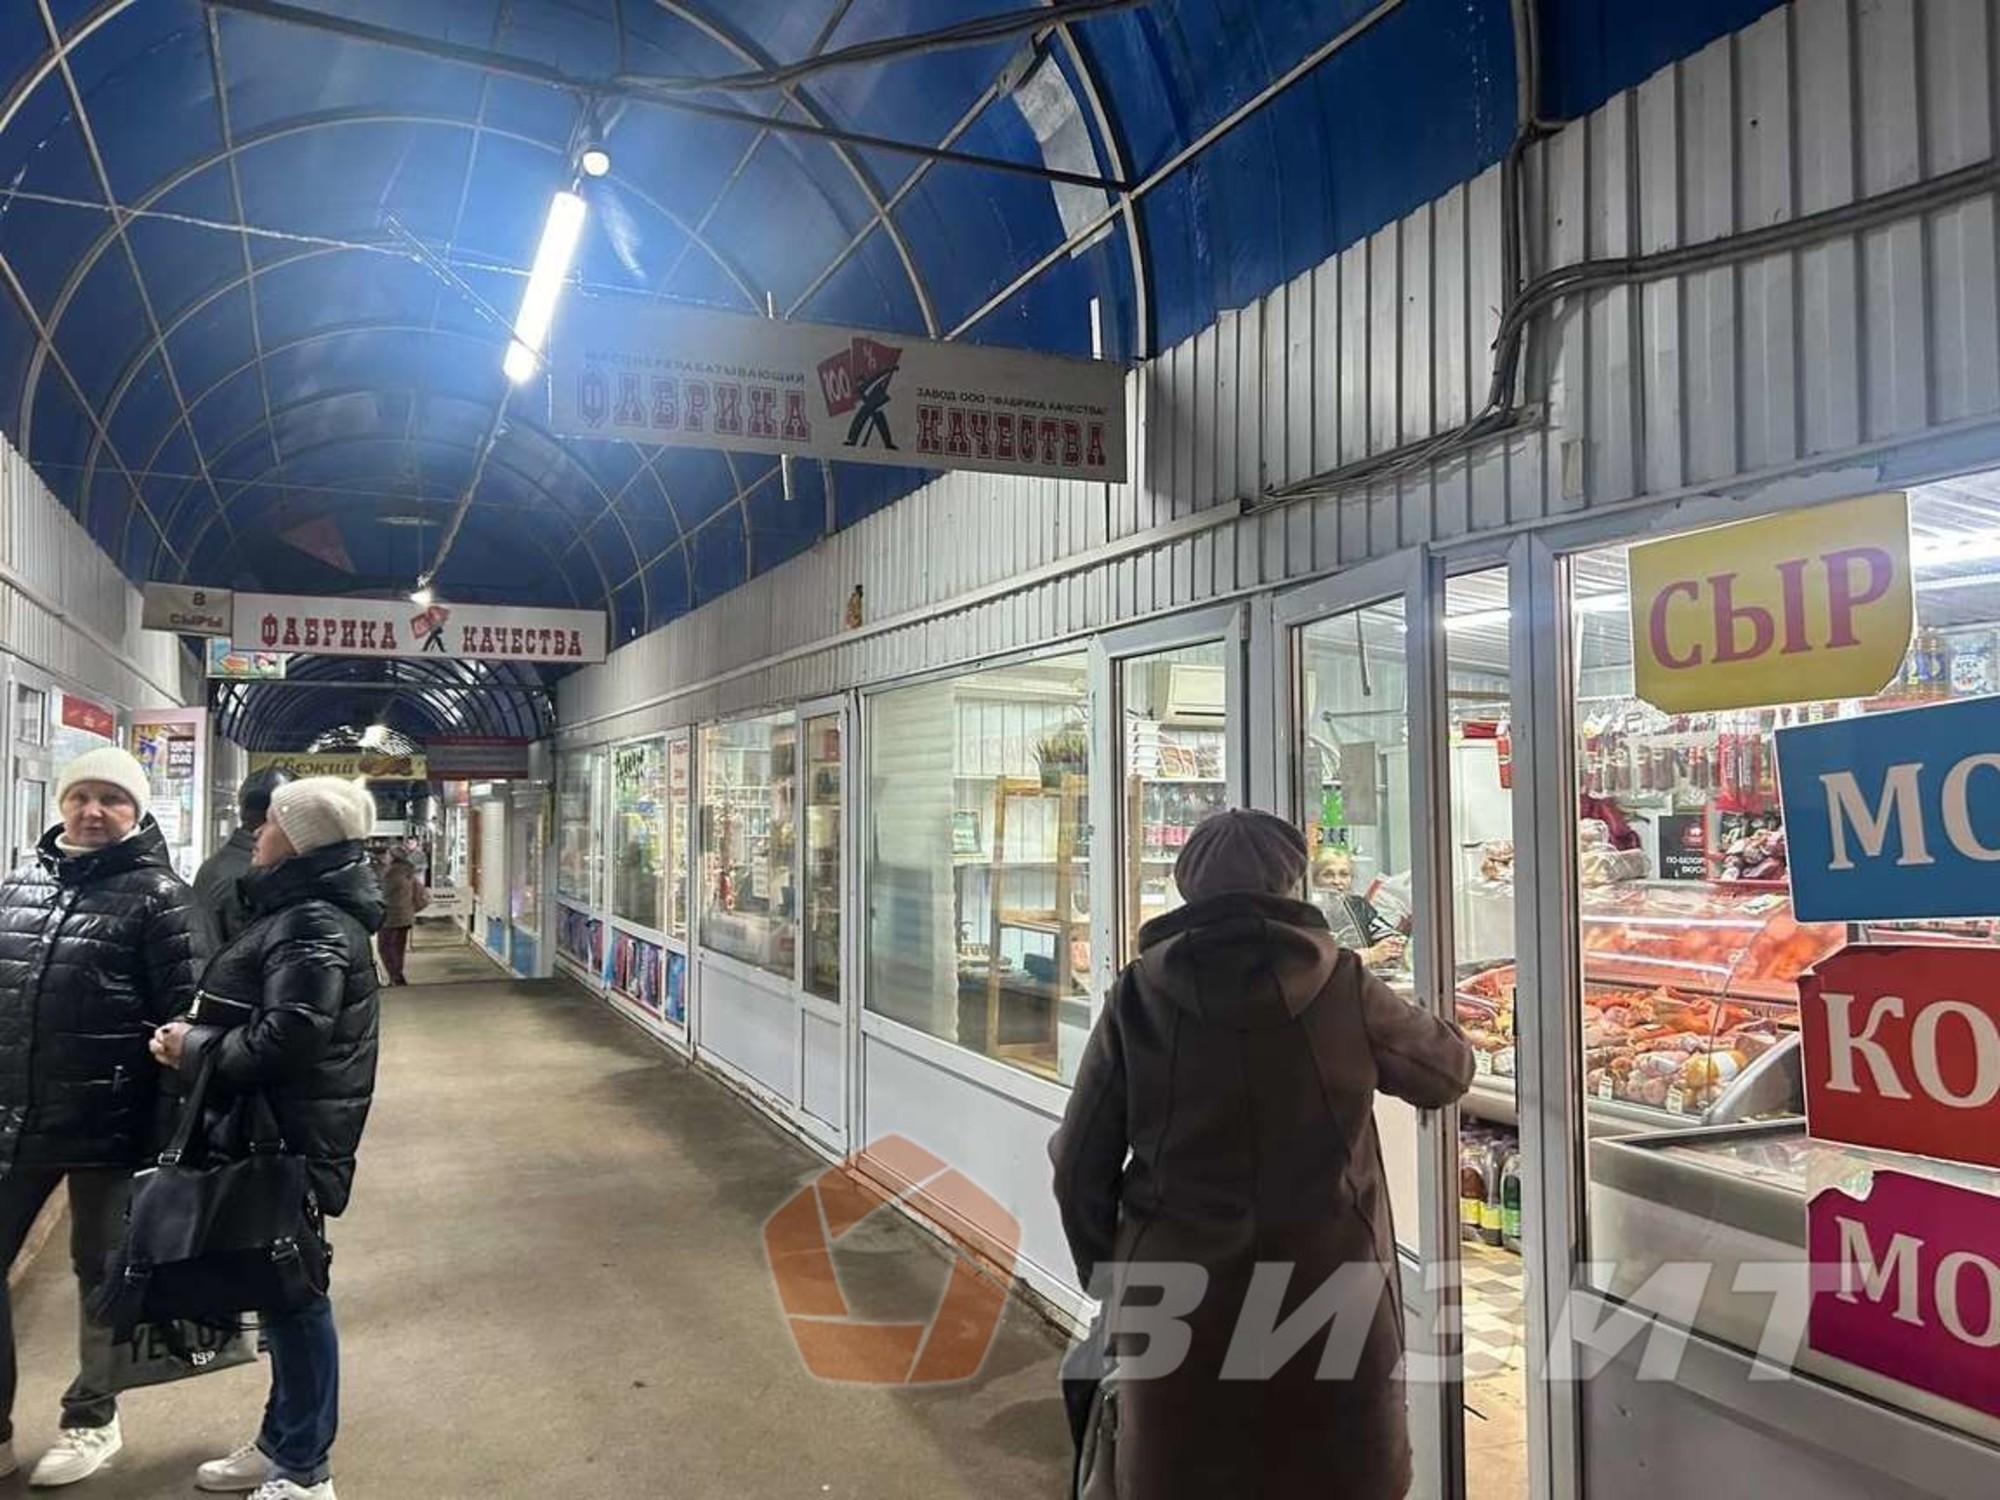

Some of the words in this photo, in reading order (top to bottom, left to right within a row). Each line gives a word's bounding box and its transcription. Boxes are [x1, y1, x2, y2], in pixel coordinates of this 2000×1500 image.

[577, 371, 812, 442] ФАБРИКА
[915, 404, 1107, 467] КАЧЕСТВА
[916, 387, 957, 401] ЗАВОД
[959, 392, 986, 404] ООО
[260, 613, 397, 649] ФАБРИКА
[463, 625, 582, 657] КАЧЕСТВА
[1649, 546, 1893, 670] СЫР
[1818, 992, 2000, 1108] КО
[1835, 1215, 2000, 1348] МО
